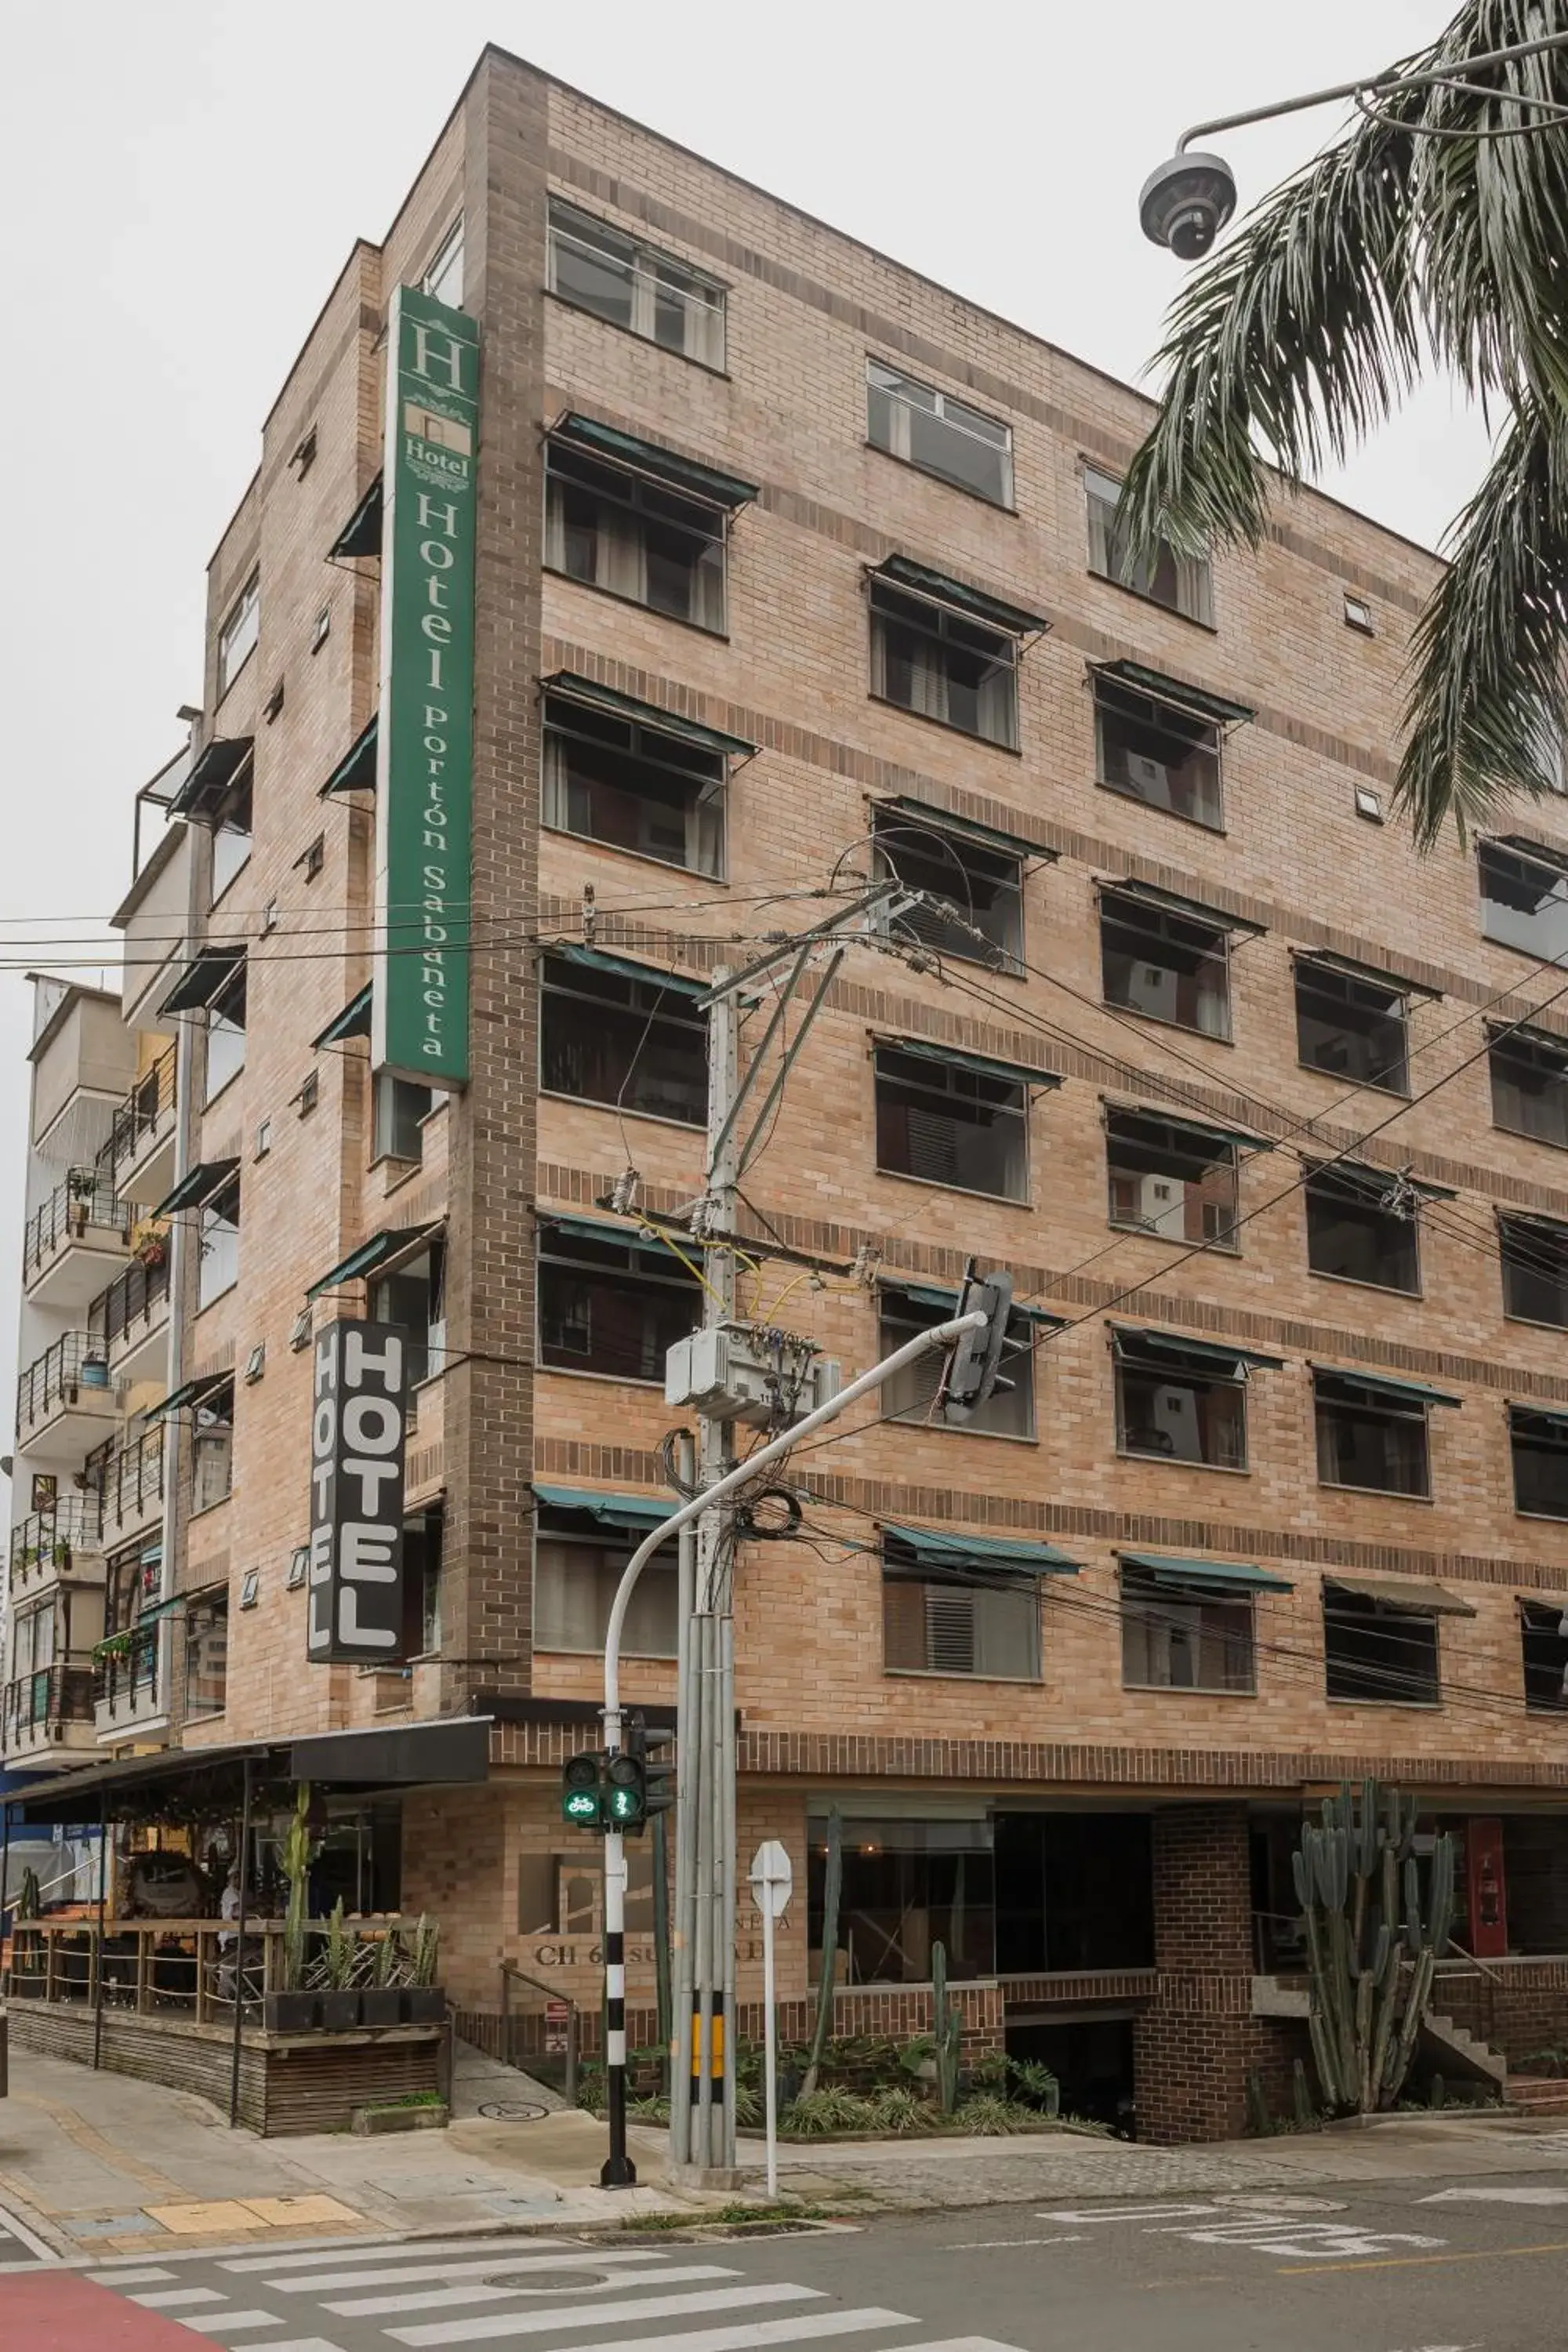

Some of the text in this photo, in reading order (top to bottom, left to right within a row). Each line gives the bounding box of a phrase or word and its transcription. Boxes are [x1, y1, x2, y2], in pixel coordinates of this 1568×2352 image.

[412, 324, 464, 393] H
[405, 438, 469, 477] Hotel
[415, 492, 459, 690] Hotel
[422, 865, 448, 1057] Sabaneta
[309, 1334, 337, 1650] HOTEL
[339, 1330, 402, 1646] HOTEL
